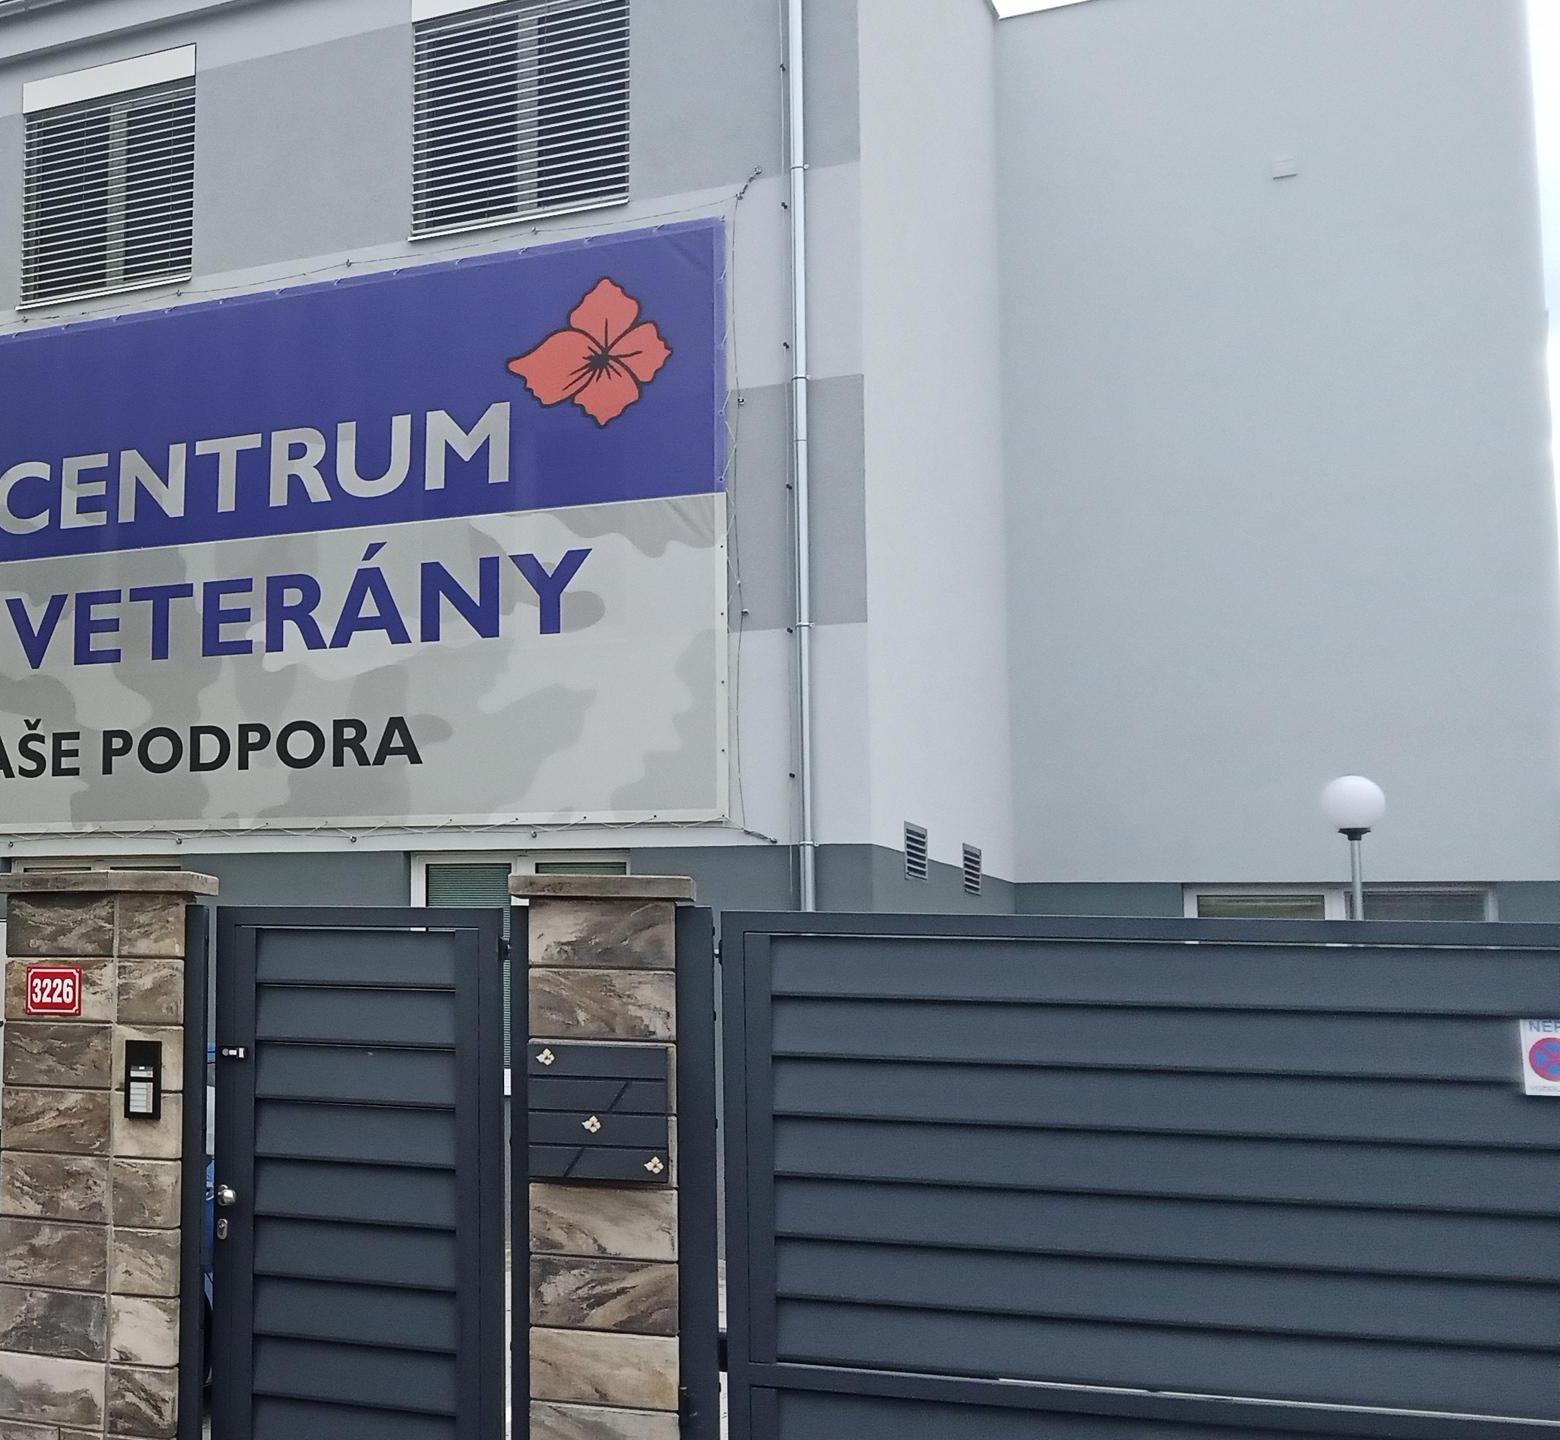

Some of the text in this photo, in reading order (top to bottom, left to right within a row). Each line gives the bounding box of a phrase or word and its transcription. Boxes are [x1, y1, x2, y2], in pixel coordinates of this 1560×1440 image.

[4, 542, 593, 669] VETERÁNY
[102, 716, 423, 776] PODPORA
[32, 978, 74, 1004] 3226
